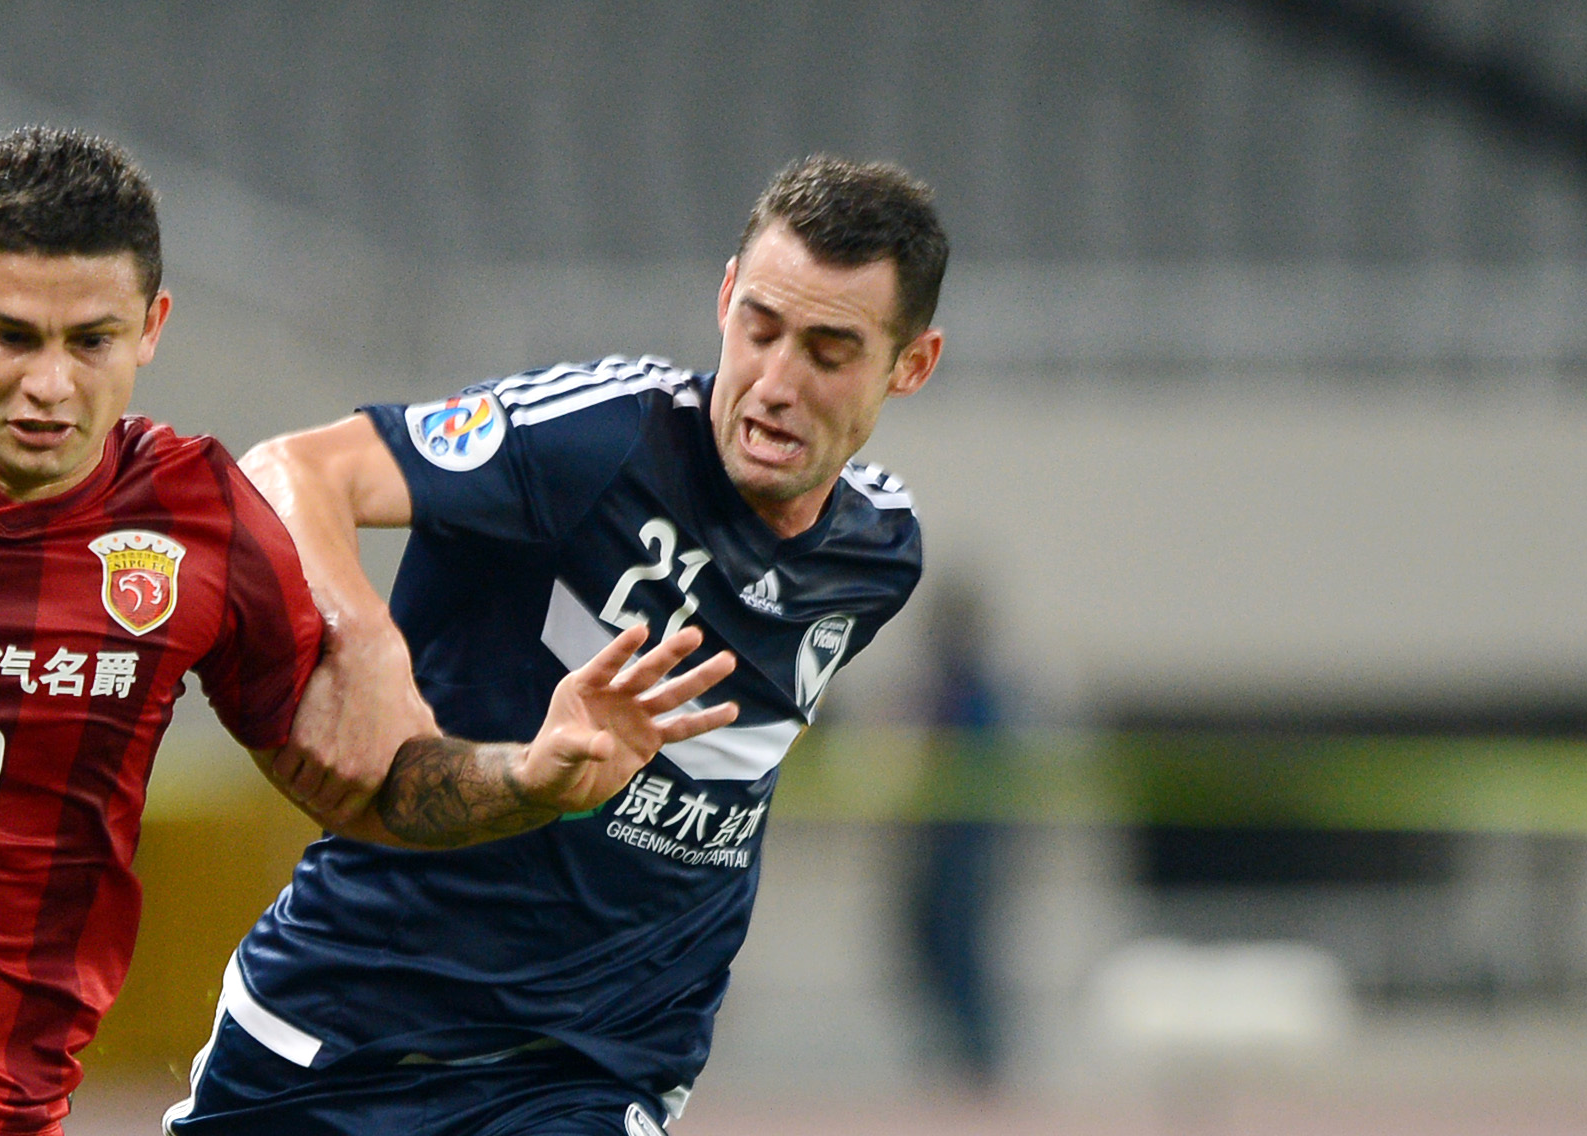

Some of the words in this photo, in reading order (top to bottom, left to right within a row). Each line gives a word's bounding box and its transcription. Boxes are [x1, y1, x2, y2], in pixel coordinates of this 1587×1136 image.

[114, 559, 145, 570] SIPG
[599, 517, 711, 642] 21
[606, 821, 703, 865] GREENWOOD
[702, 848, 750, 868] CAPITAL
